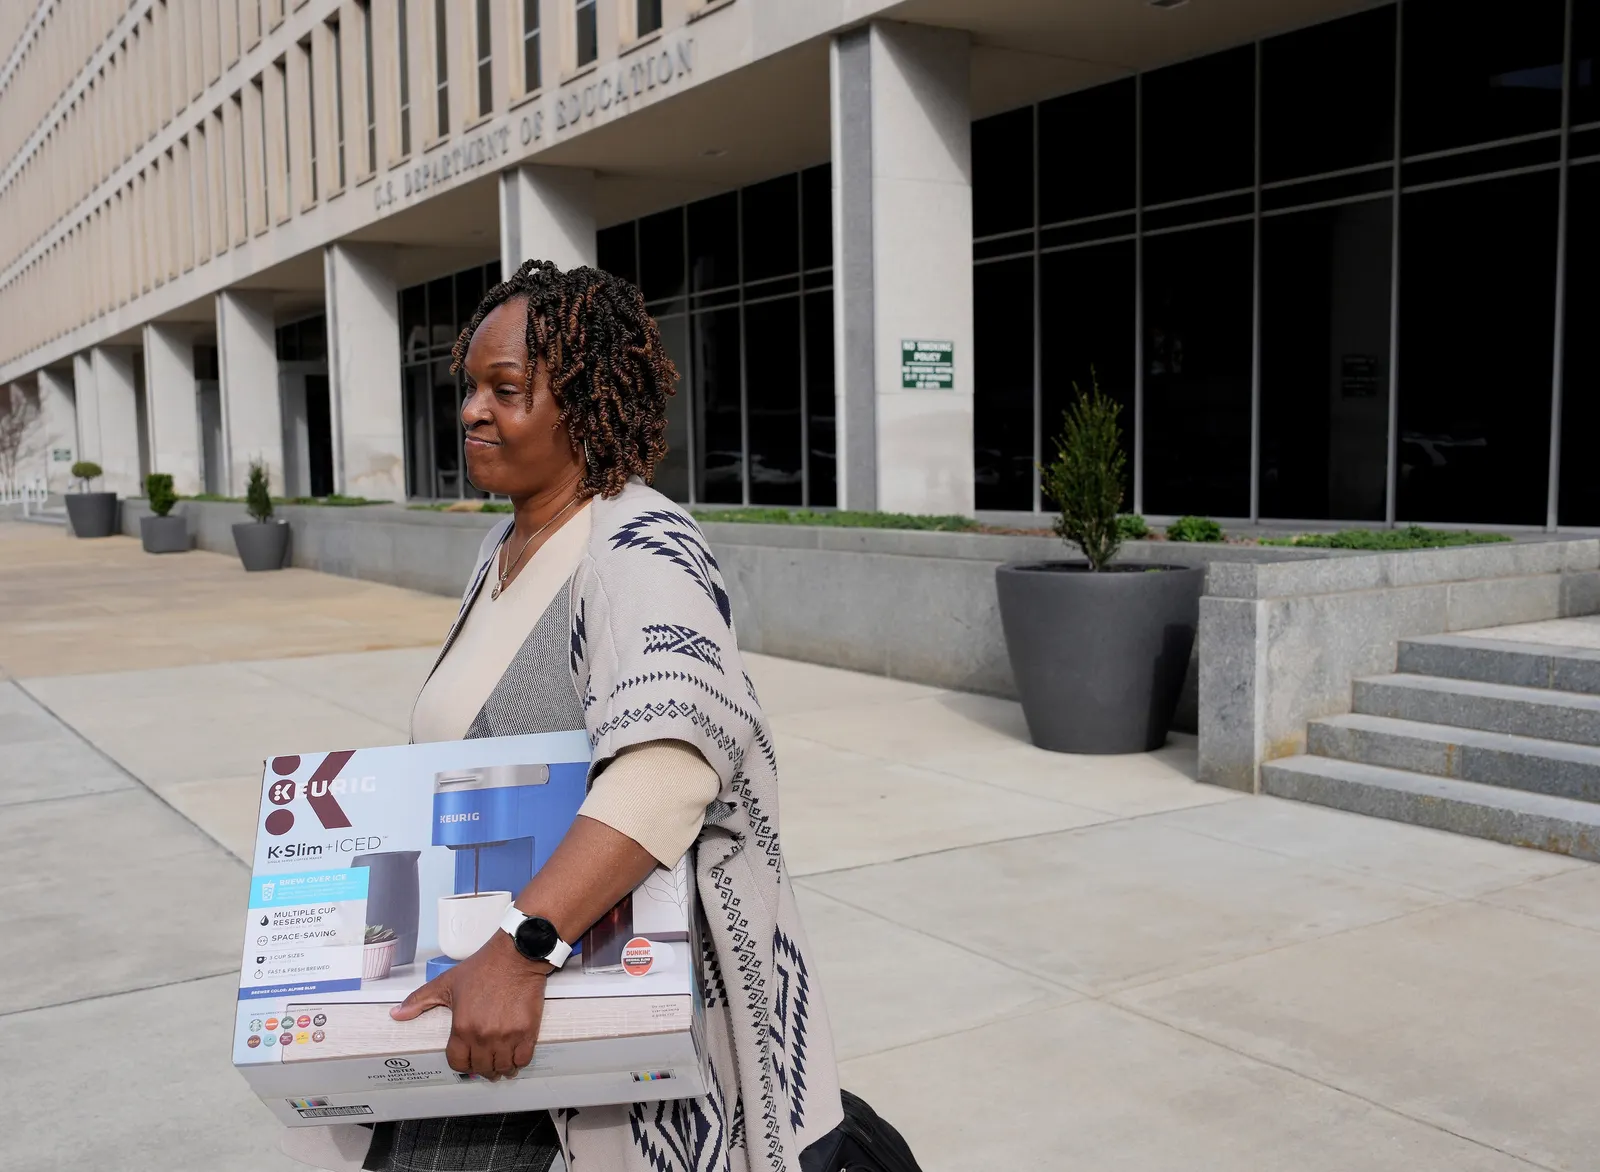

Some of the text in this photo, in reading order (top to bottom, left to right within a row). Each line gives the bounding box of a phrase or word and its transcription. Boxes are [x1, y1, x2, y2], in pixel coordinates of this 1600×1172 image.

[373, 38, 695, 211] U.S. DEPARTMENT OF EDUCATION
[439, 812, 480, 824] KEURIG
[279, 873, 348, 886] BREW OVER ICE
[273, 907, 336, 918] MULTIPLE CUP
[273, 916, 322, 926] RESERVOIR
[271, 930, 337, 942] SPACE-SAVING
[387, 1070, 442, 1078] HOUSEHOLD
